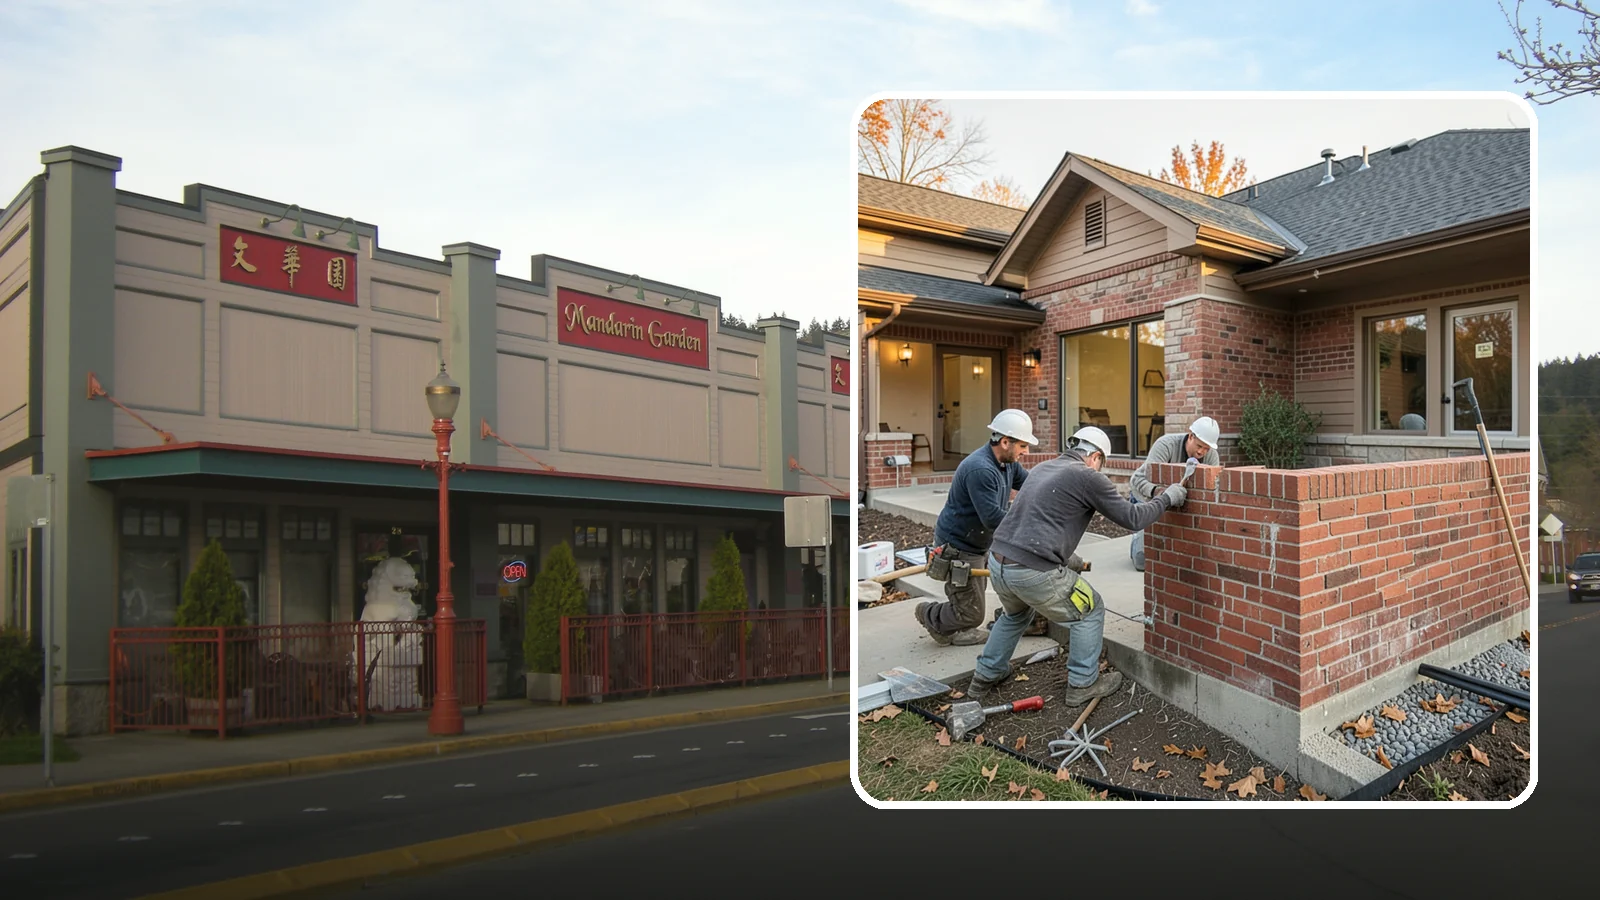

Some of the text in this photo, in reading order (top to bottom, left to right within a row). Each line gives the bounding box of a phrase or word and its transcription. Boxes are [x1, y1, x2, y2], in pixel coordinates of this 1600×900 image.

[230, 235, 347, 291] 文華園
[564, 302, 701, 352] Mandarin Garden
[503, 565, 527, 578] OPEN
